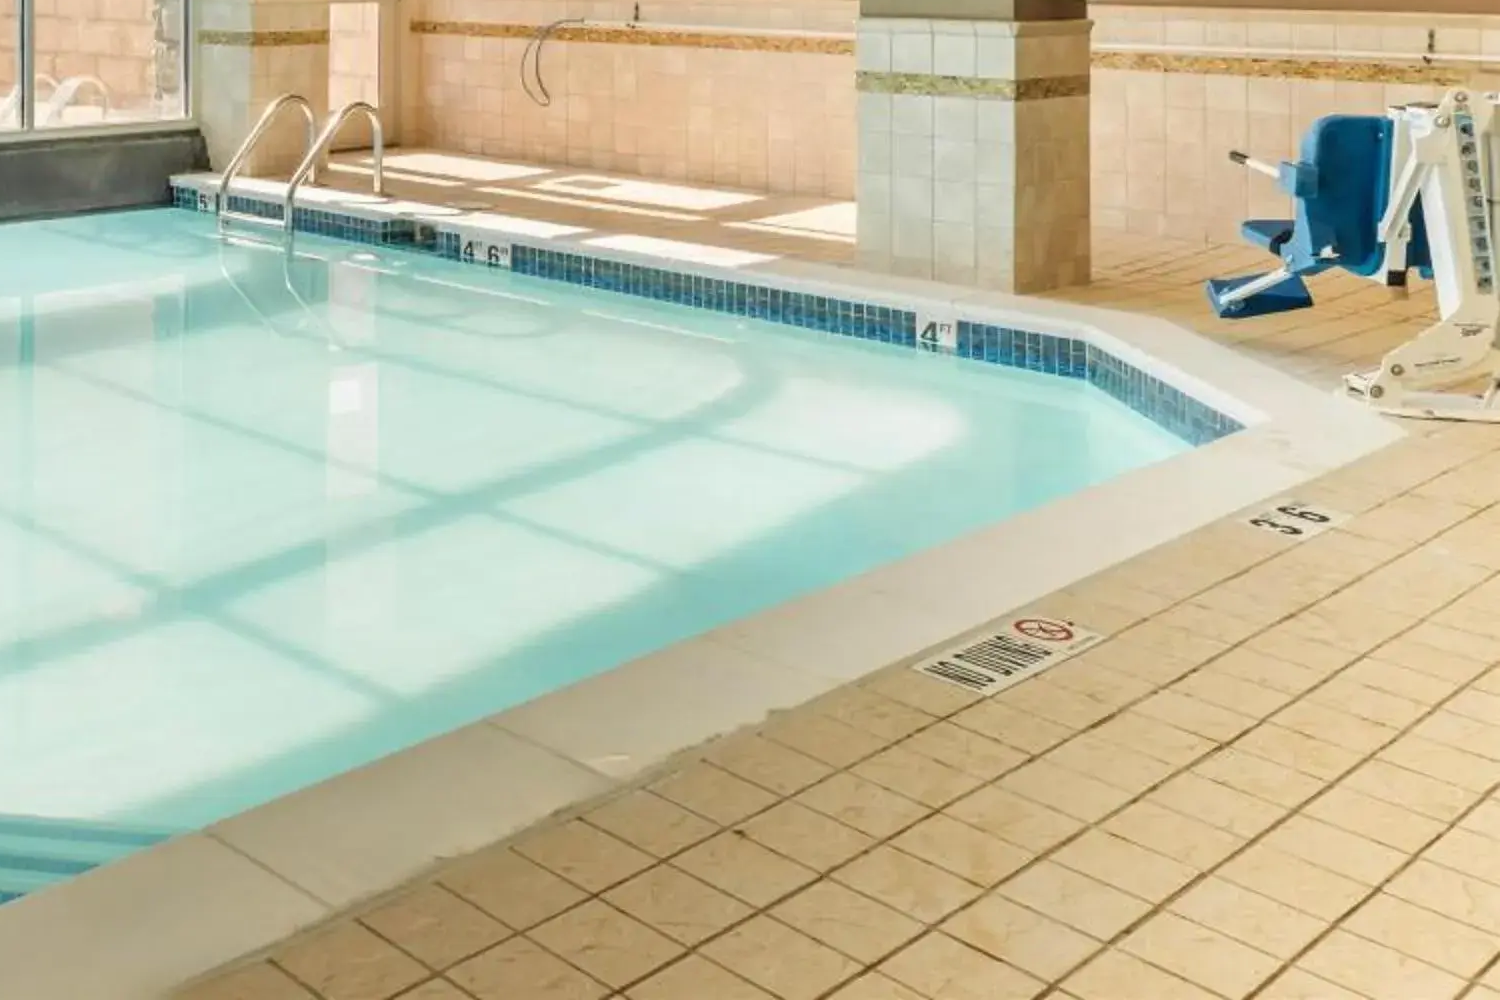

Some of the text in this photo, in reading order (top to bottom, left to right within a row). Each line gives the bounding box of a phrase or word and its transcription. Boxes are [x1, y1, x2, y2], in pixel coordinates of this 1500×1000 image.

[463, 240, 475, 258] 4
[488, 244, 500, 263] 6
[1249, 506, 1330, 535] 3 6
[952, 634, 1053, 677] DIVING
[923, 660, 996, 691] NO
